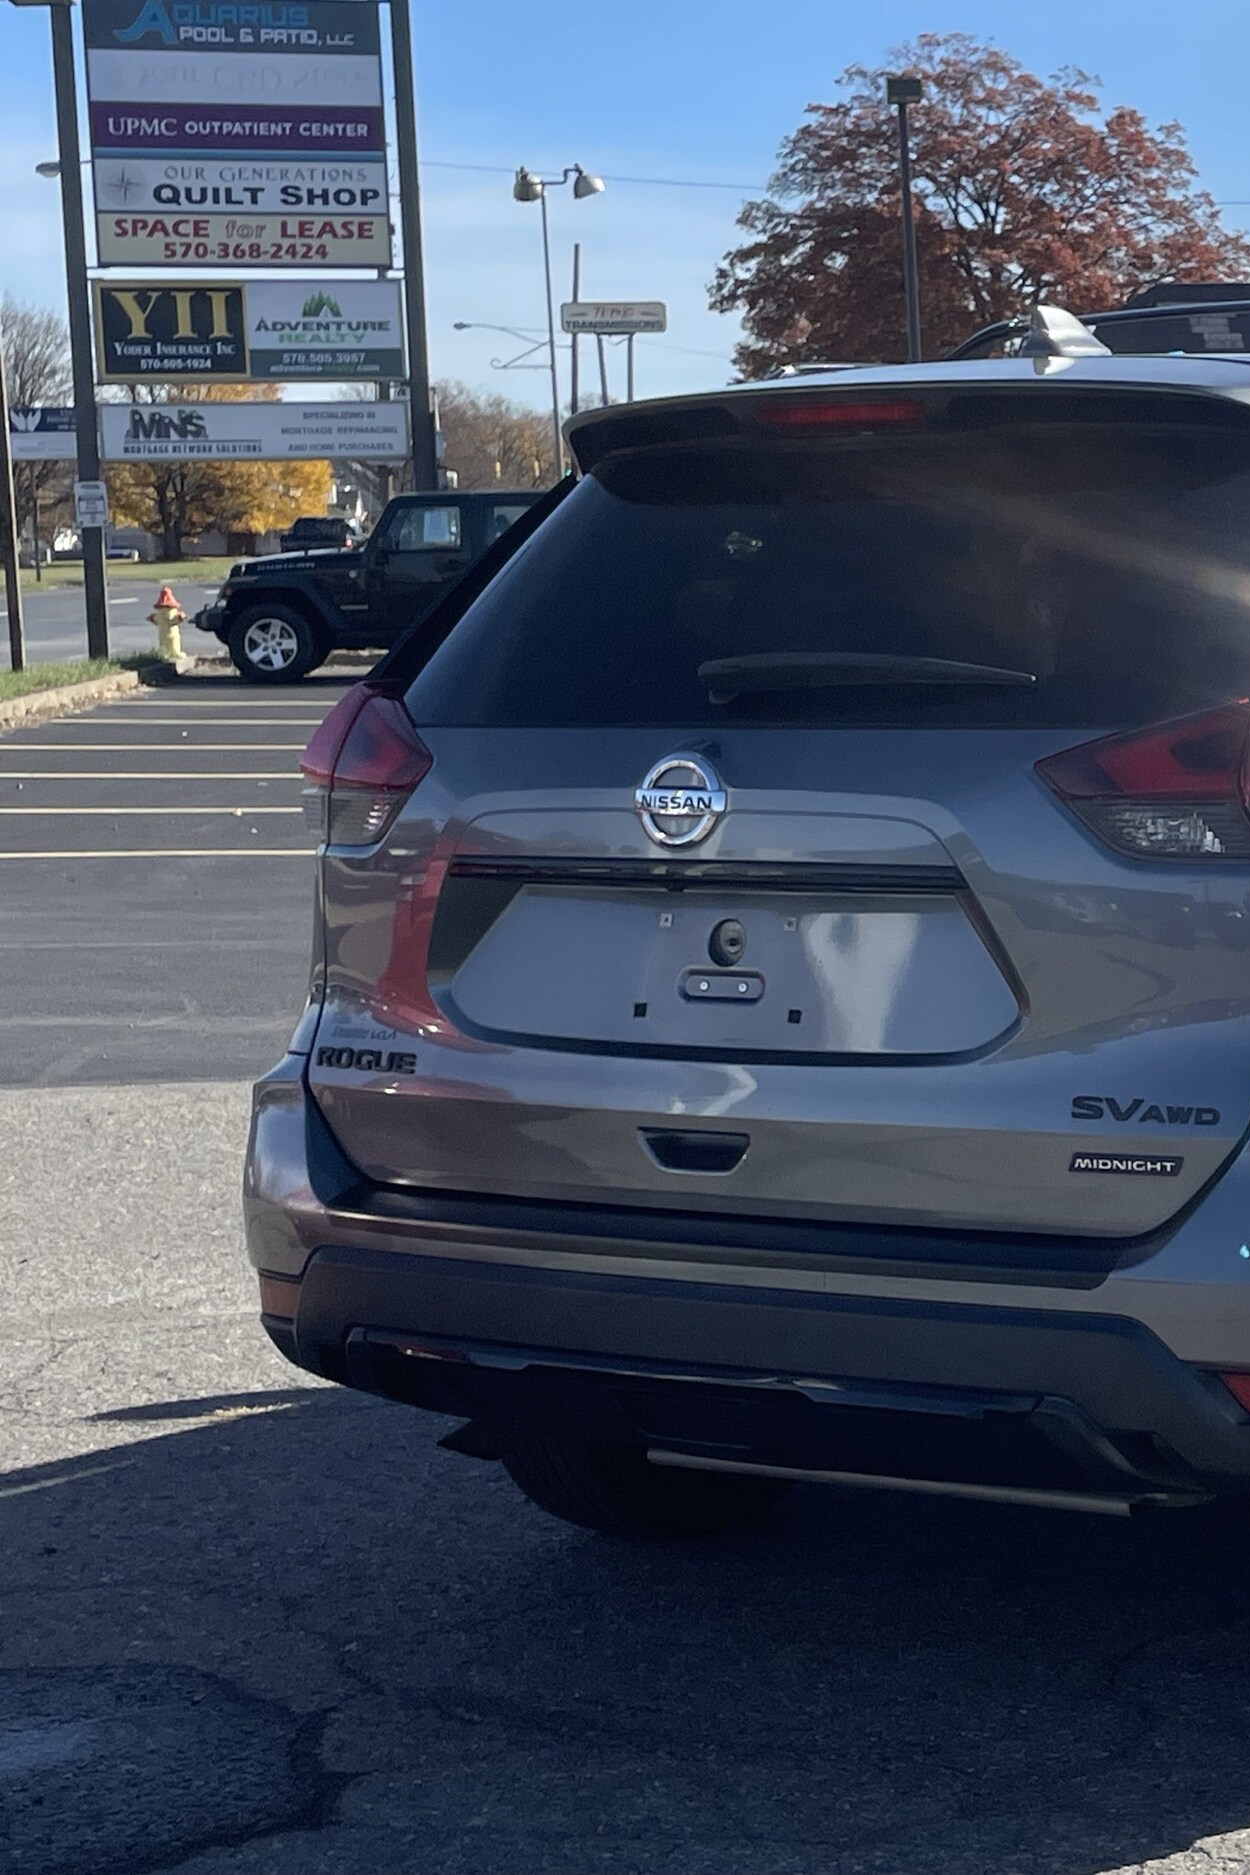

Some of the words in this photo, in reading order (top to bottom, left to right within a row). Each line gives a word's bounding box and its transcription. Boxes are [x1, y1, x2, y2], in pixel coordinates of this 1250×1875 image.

[113, 0, 310, 44] AQUARIUS
[179, 27, 235, 43] POOL
[239, 28, 253, 43] &
[260, 28, 322, 46] PATIO,
[326, 33, 355, 46] LLC
[107, 117, 177, 137] UPMC
[184, 121, 292, 136] OUTPATIENT
[299, 123, 368, 138] CENTER
[164, 166, 206, 181] OUR
[219, 166, 367, 182] GENERATIONS
[152, 183, 265, 206] QUILT
[279, 185, 380, 206] SHOP
[114, 218, 211, 238] SPACE
[225, 219, 267, 239] for
[280, 220, 374, 240] LEASE
[163, 242, 329, 260] 570-368-2424
[111, 291, 234, 339] YII
[255, 317, 391, 332] ADVENTURE
[278, 333, 366, 343] REALTY
[641, 794, 713, 810] NISSAN
[316, 1046, 418, 1075] ROGUE
[1074, 1158, 1177, 1173] MIDNIGHT
